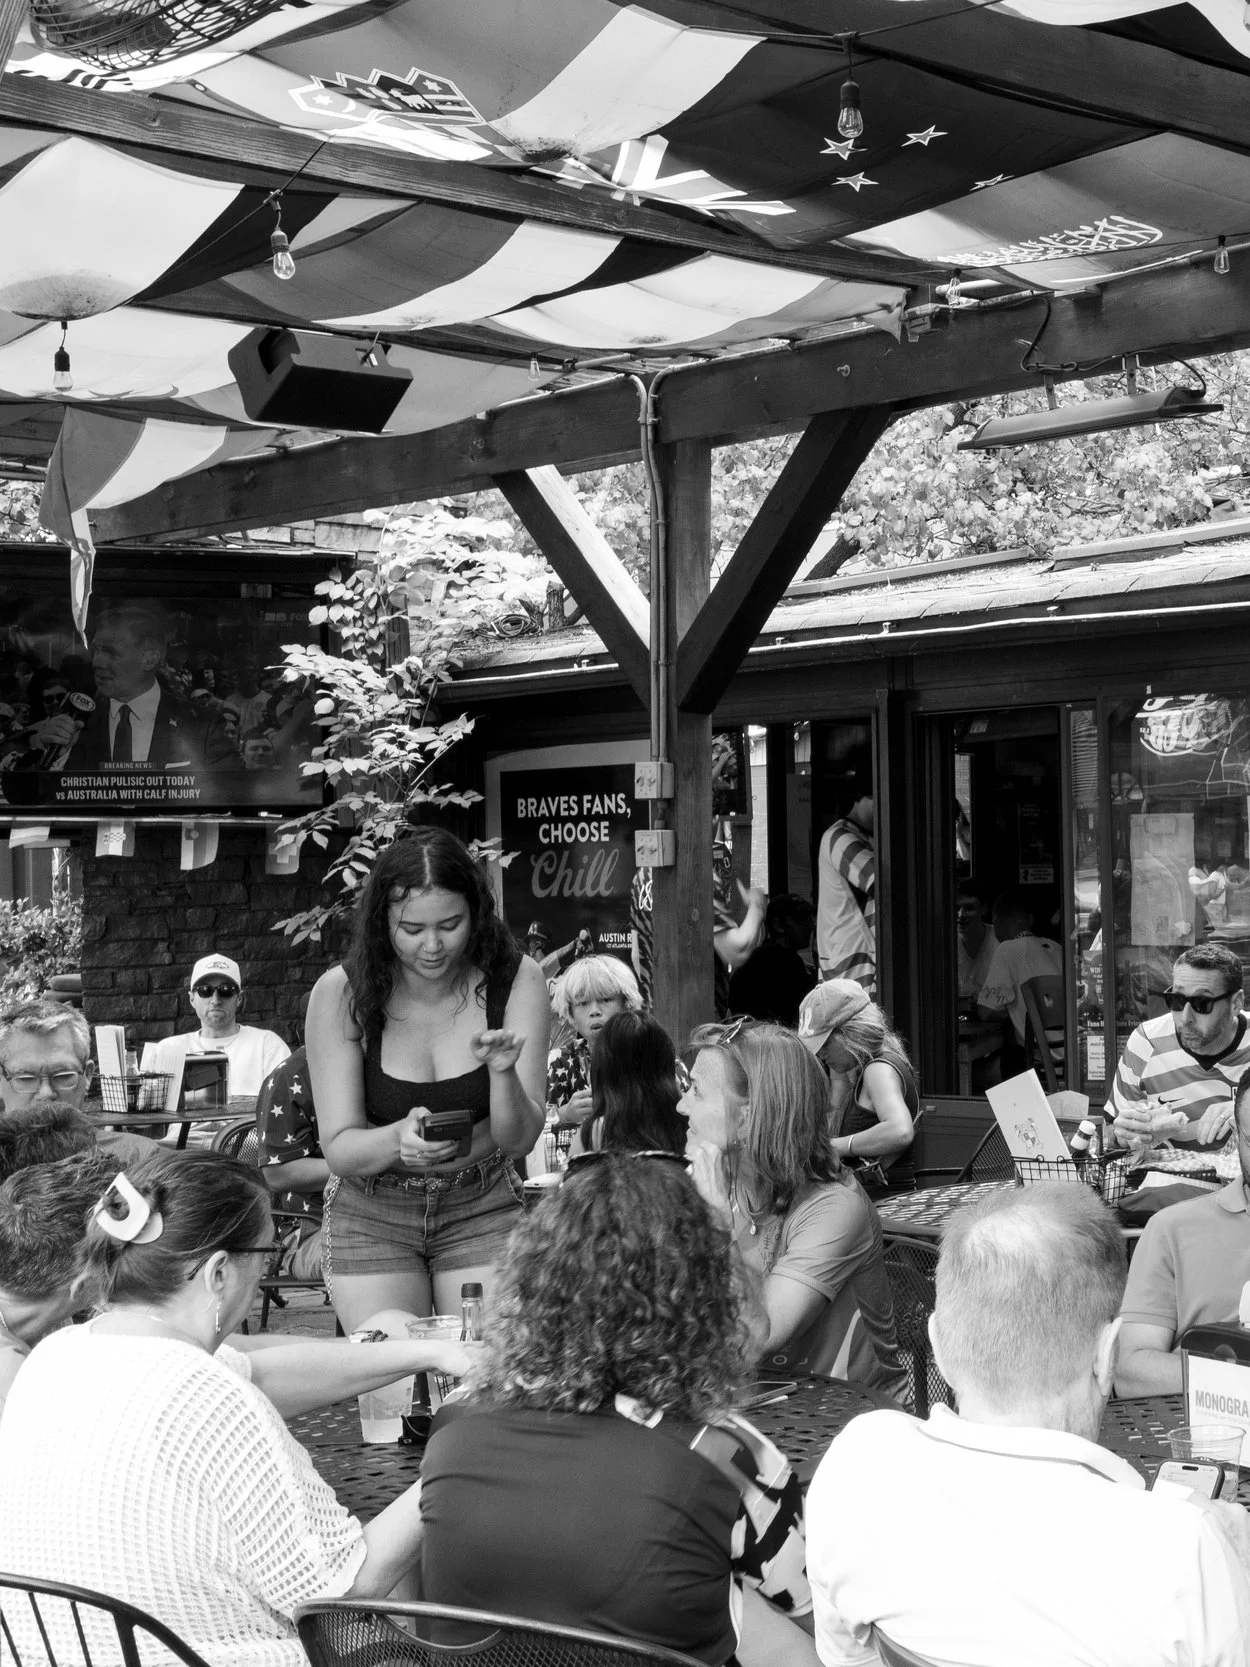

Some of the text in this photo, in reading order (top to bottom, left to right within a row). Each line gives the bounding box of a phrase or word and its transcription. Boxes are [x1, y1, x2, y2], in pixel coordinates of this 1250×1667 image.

[75, 695, 91, 708] FOX
[105, 762, 134, 770] BREAKING
[60, 775, 196, 787] CHRISTIAN PULISIC OUT TODAY
[55, 788, 201, 800] vs AUSTRALIA WITH CALF INJURY
[517, 792, 632, 819] BRAVES FANS,
[539, 821, 610, 844] CHOOSE
[530, 848, 620, 899] Chill
[598, 932, 626, 943] AUSTIN
